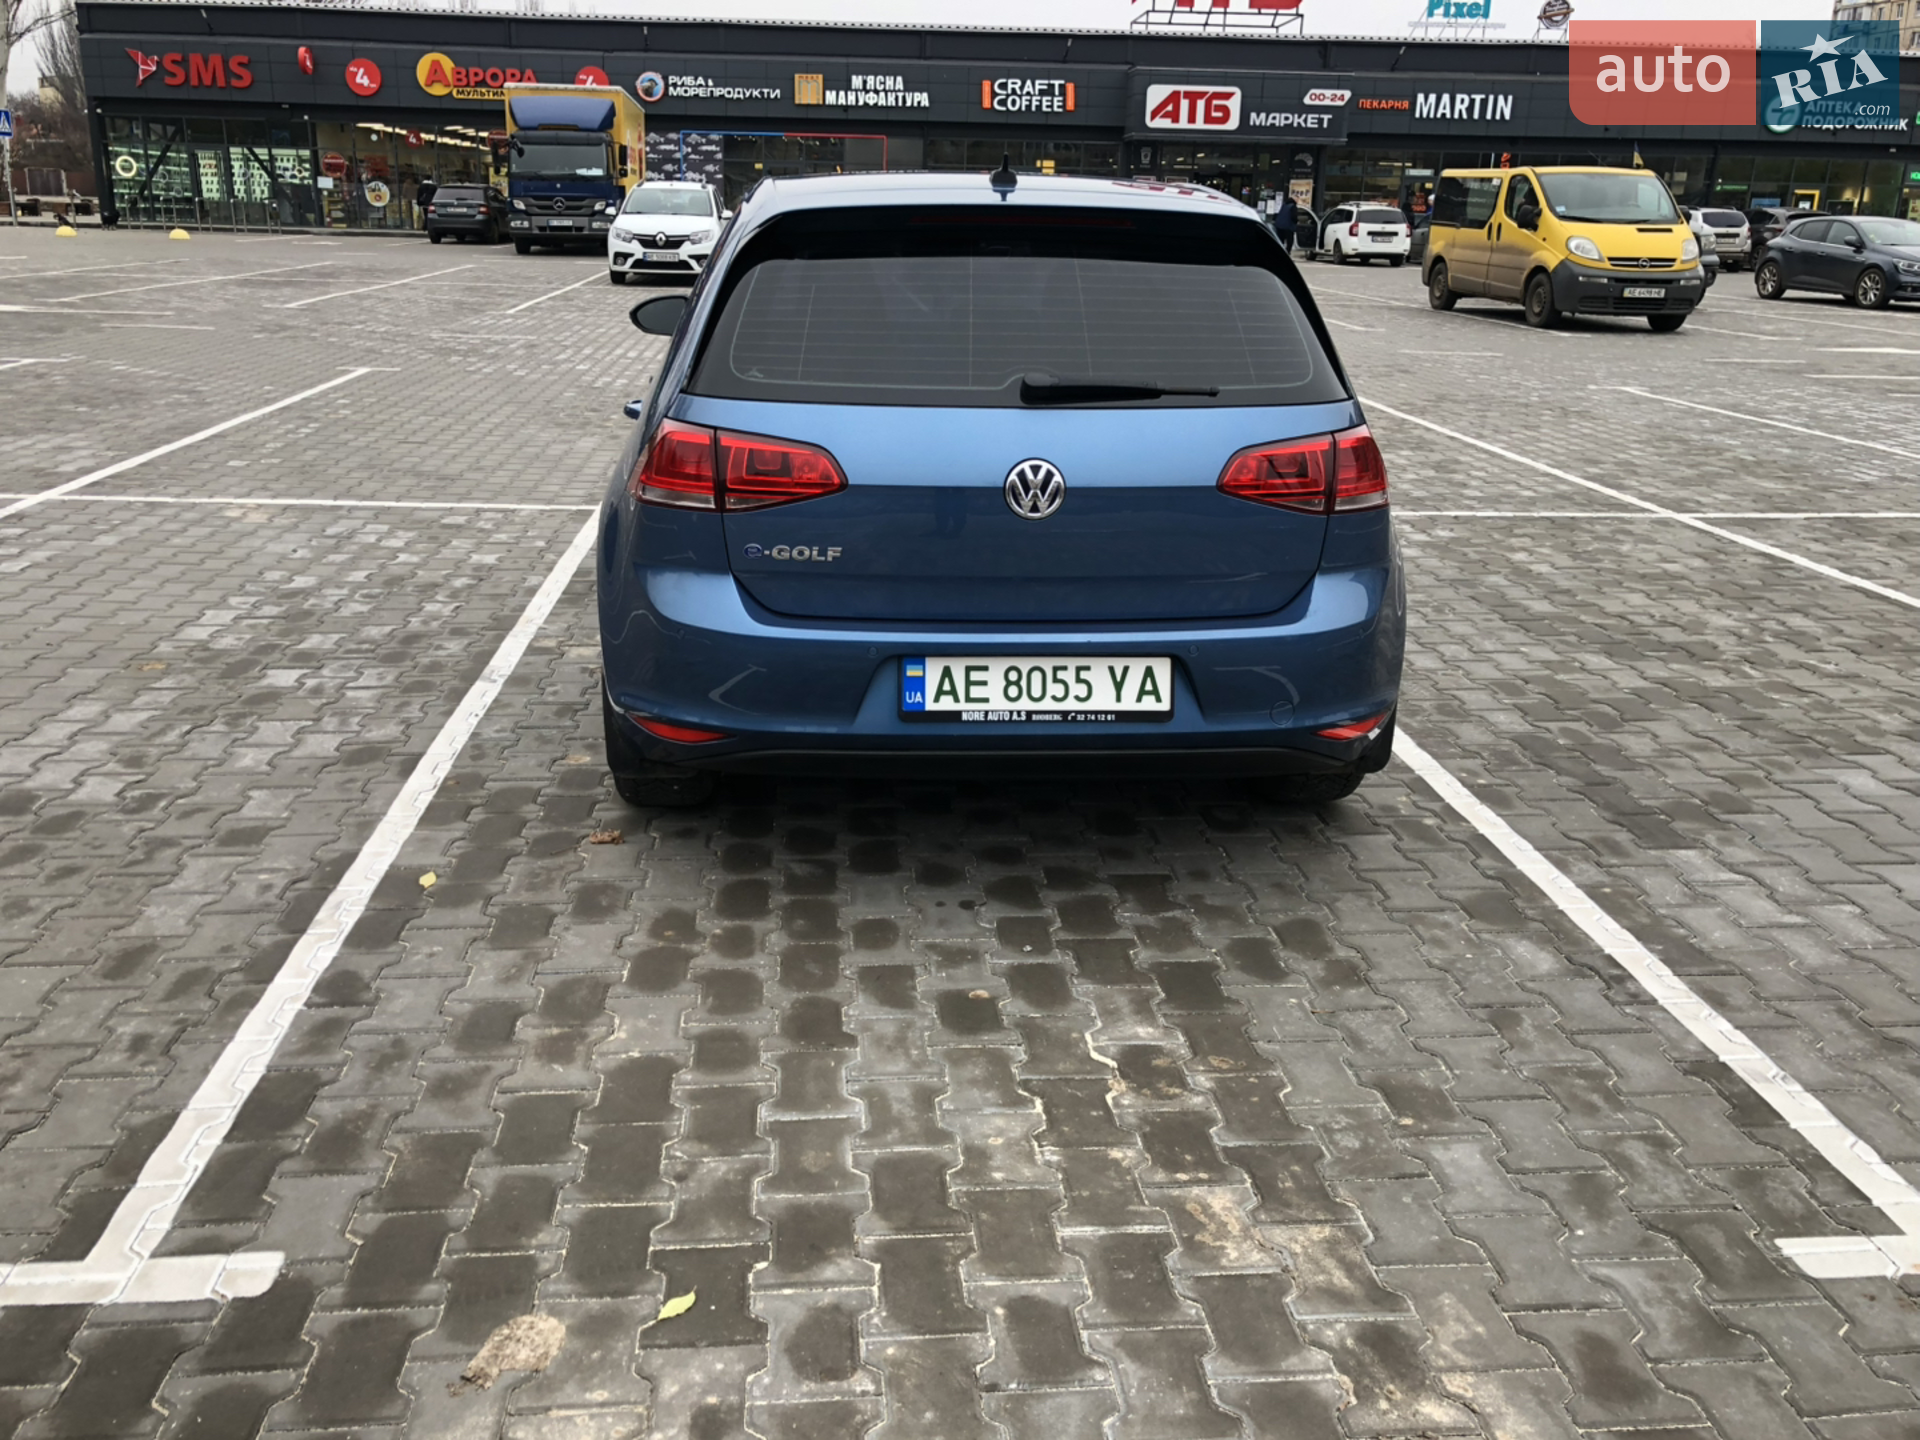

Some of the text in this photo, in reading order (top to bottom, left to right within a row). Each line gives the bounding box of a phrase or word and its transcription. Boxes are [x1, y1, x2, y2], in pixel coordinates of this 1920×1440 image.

[1427, 0, 1491, 19] Pixel
[162, 52, 254, 88] SMS
[424, 59, 538, 88] АВРОРА
[668, 75, 706, 86] РИБА
[851, 74, 904, 91] М'ЯСНА
[993, 78, 1065, 96] CRAFT
[668, 86, 781, 100] МОРЕПРОДУКТИ
[825, 90, 930, 107] МАНУФАКТУРА
[1309, 93, 1345, 103] 00-24
[993, 95, 1064, 112] COFFEE
[1150, 90, 1237, 125] АТБ
[1358, 98, 1409, 110] ПЕКАРНЯ
[1415, 92, 1513, 120] MARTIN
[1249, 111, 1333, 128] МАРКЕТ
[1801, 114, 1908, 131] ПОДОРОЖНИК
[933, 664, 1162, 704] AE 8055 YA
[906, 691, 924, 703] UA
[962, 711, 985, 721] NORE
[987, 711, 1010, 721] AUTO
